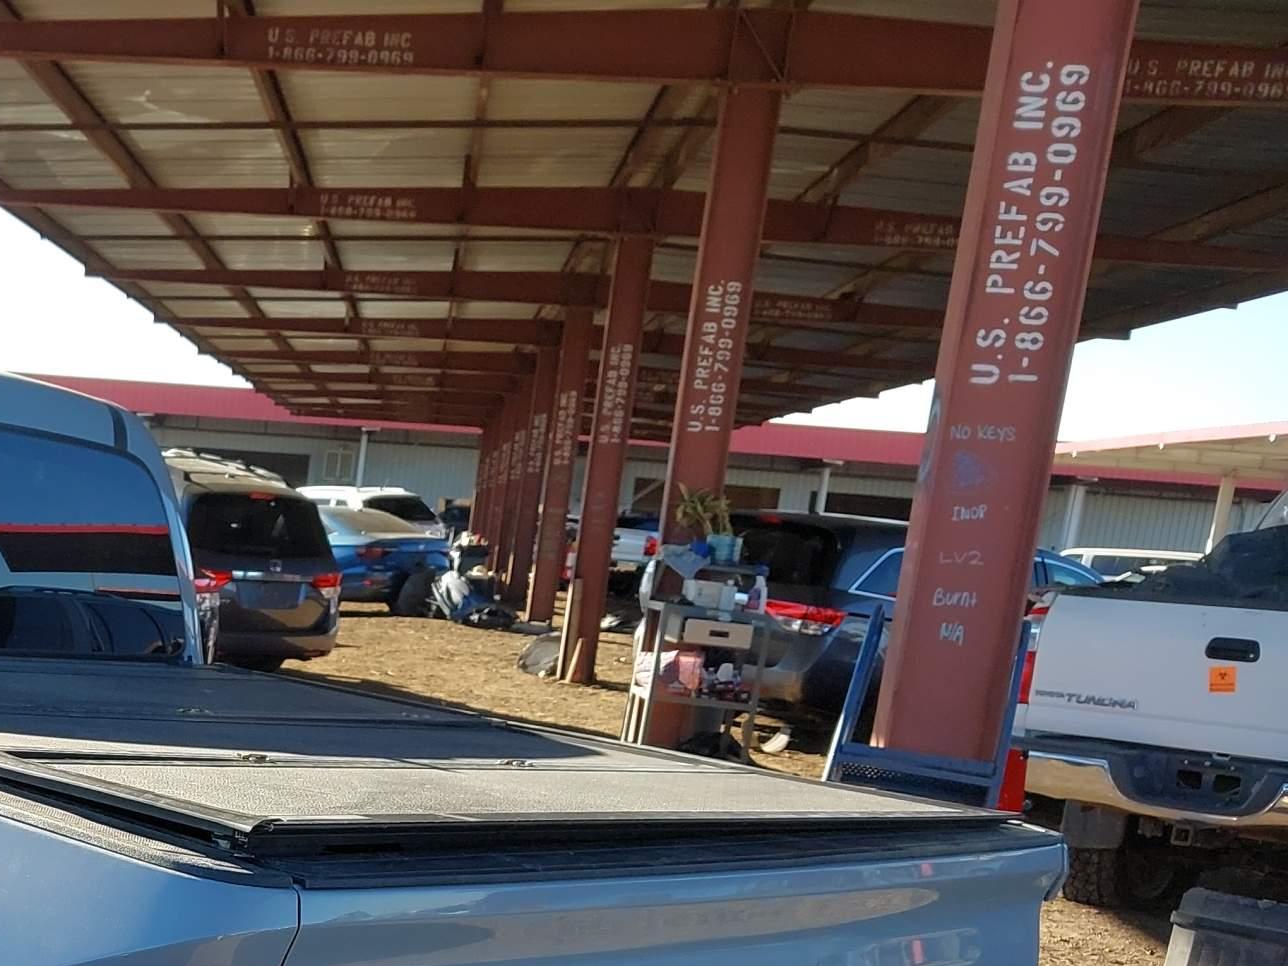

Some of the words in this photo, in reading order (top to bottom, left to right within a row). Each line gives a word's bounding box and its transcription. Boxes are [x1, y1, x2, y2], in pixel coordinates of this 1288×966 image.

[309, 29, 376, 47] PREFAB
[1176, 60, 1255, 78] PREFAB
[1013, 61, 1054, 130] INC.
[985, 151, 1038, 294] PREFAB
[1007, 64, 1090, 383] 1-866-799-0969
[693, 321, 718, 390] PREFAB
[704, 281, 743, 432] 1-866-799-0969
[969, 316, 1010, 385] U.S.
[951, 424, 971, 440] NO
[977, 423, 1016, 444] KEYS
